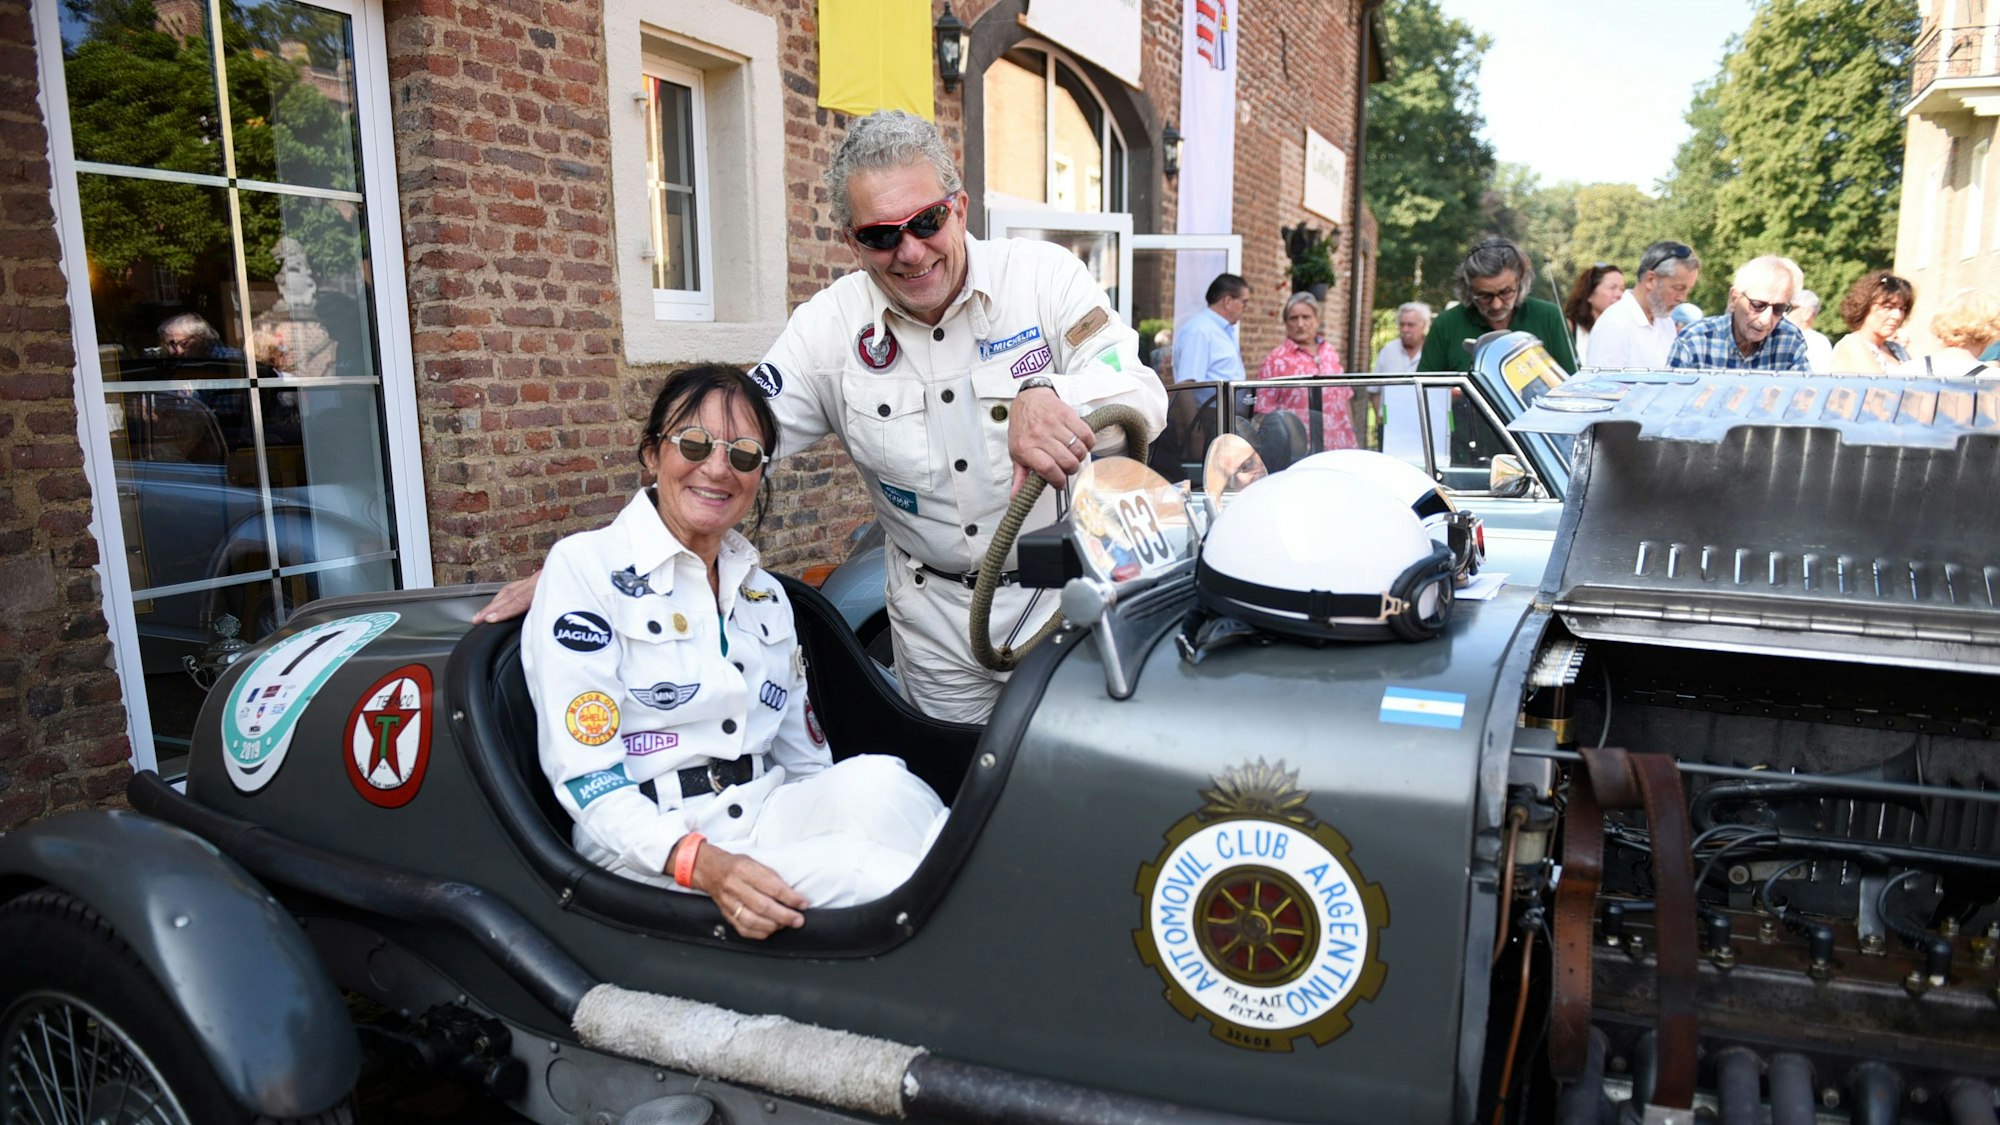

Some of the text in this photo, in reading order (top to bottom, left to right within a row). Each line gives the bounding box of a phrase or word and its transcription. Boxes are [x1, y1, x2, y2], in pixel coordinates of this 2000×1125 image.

[993, 328, 1037, 352] MICHELIN
[1119, 495, 1169, 565] 63
[555, 628, 609, 645] JAGUAR
[279, 630, 346, 677] 1
[568, 694, 617, 714] MOTOR OIL
[655, 691, 676, 701] MINI
[579, 713, 609, 722] SHELL
[374, 715, 400, 759] T
[623, 734, 674, 752] AGUAR
[240, 740, 261, 760] 2019
[1159, 829, 1359, 1017] AUTOMOVIL CLUB ARGENTINO
